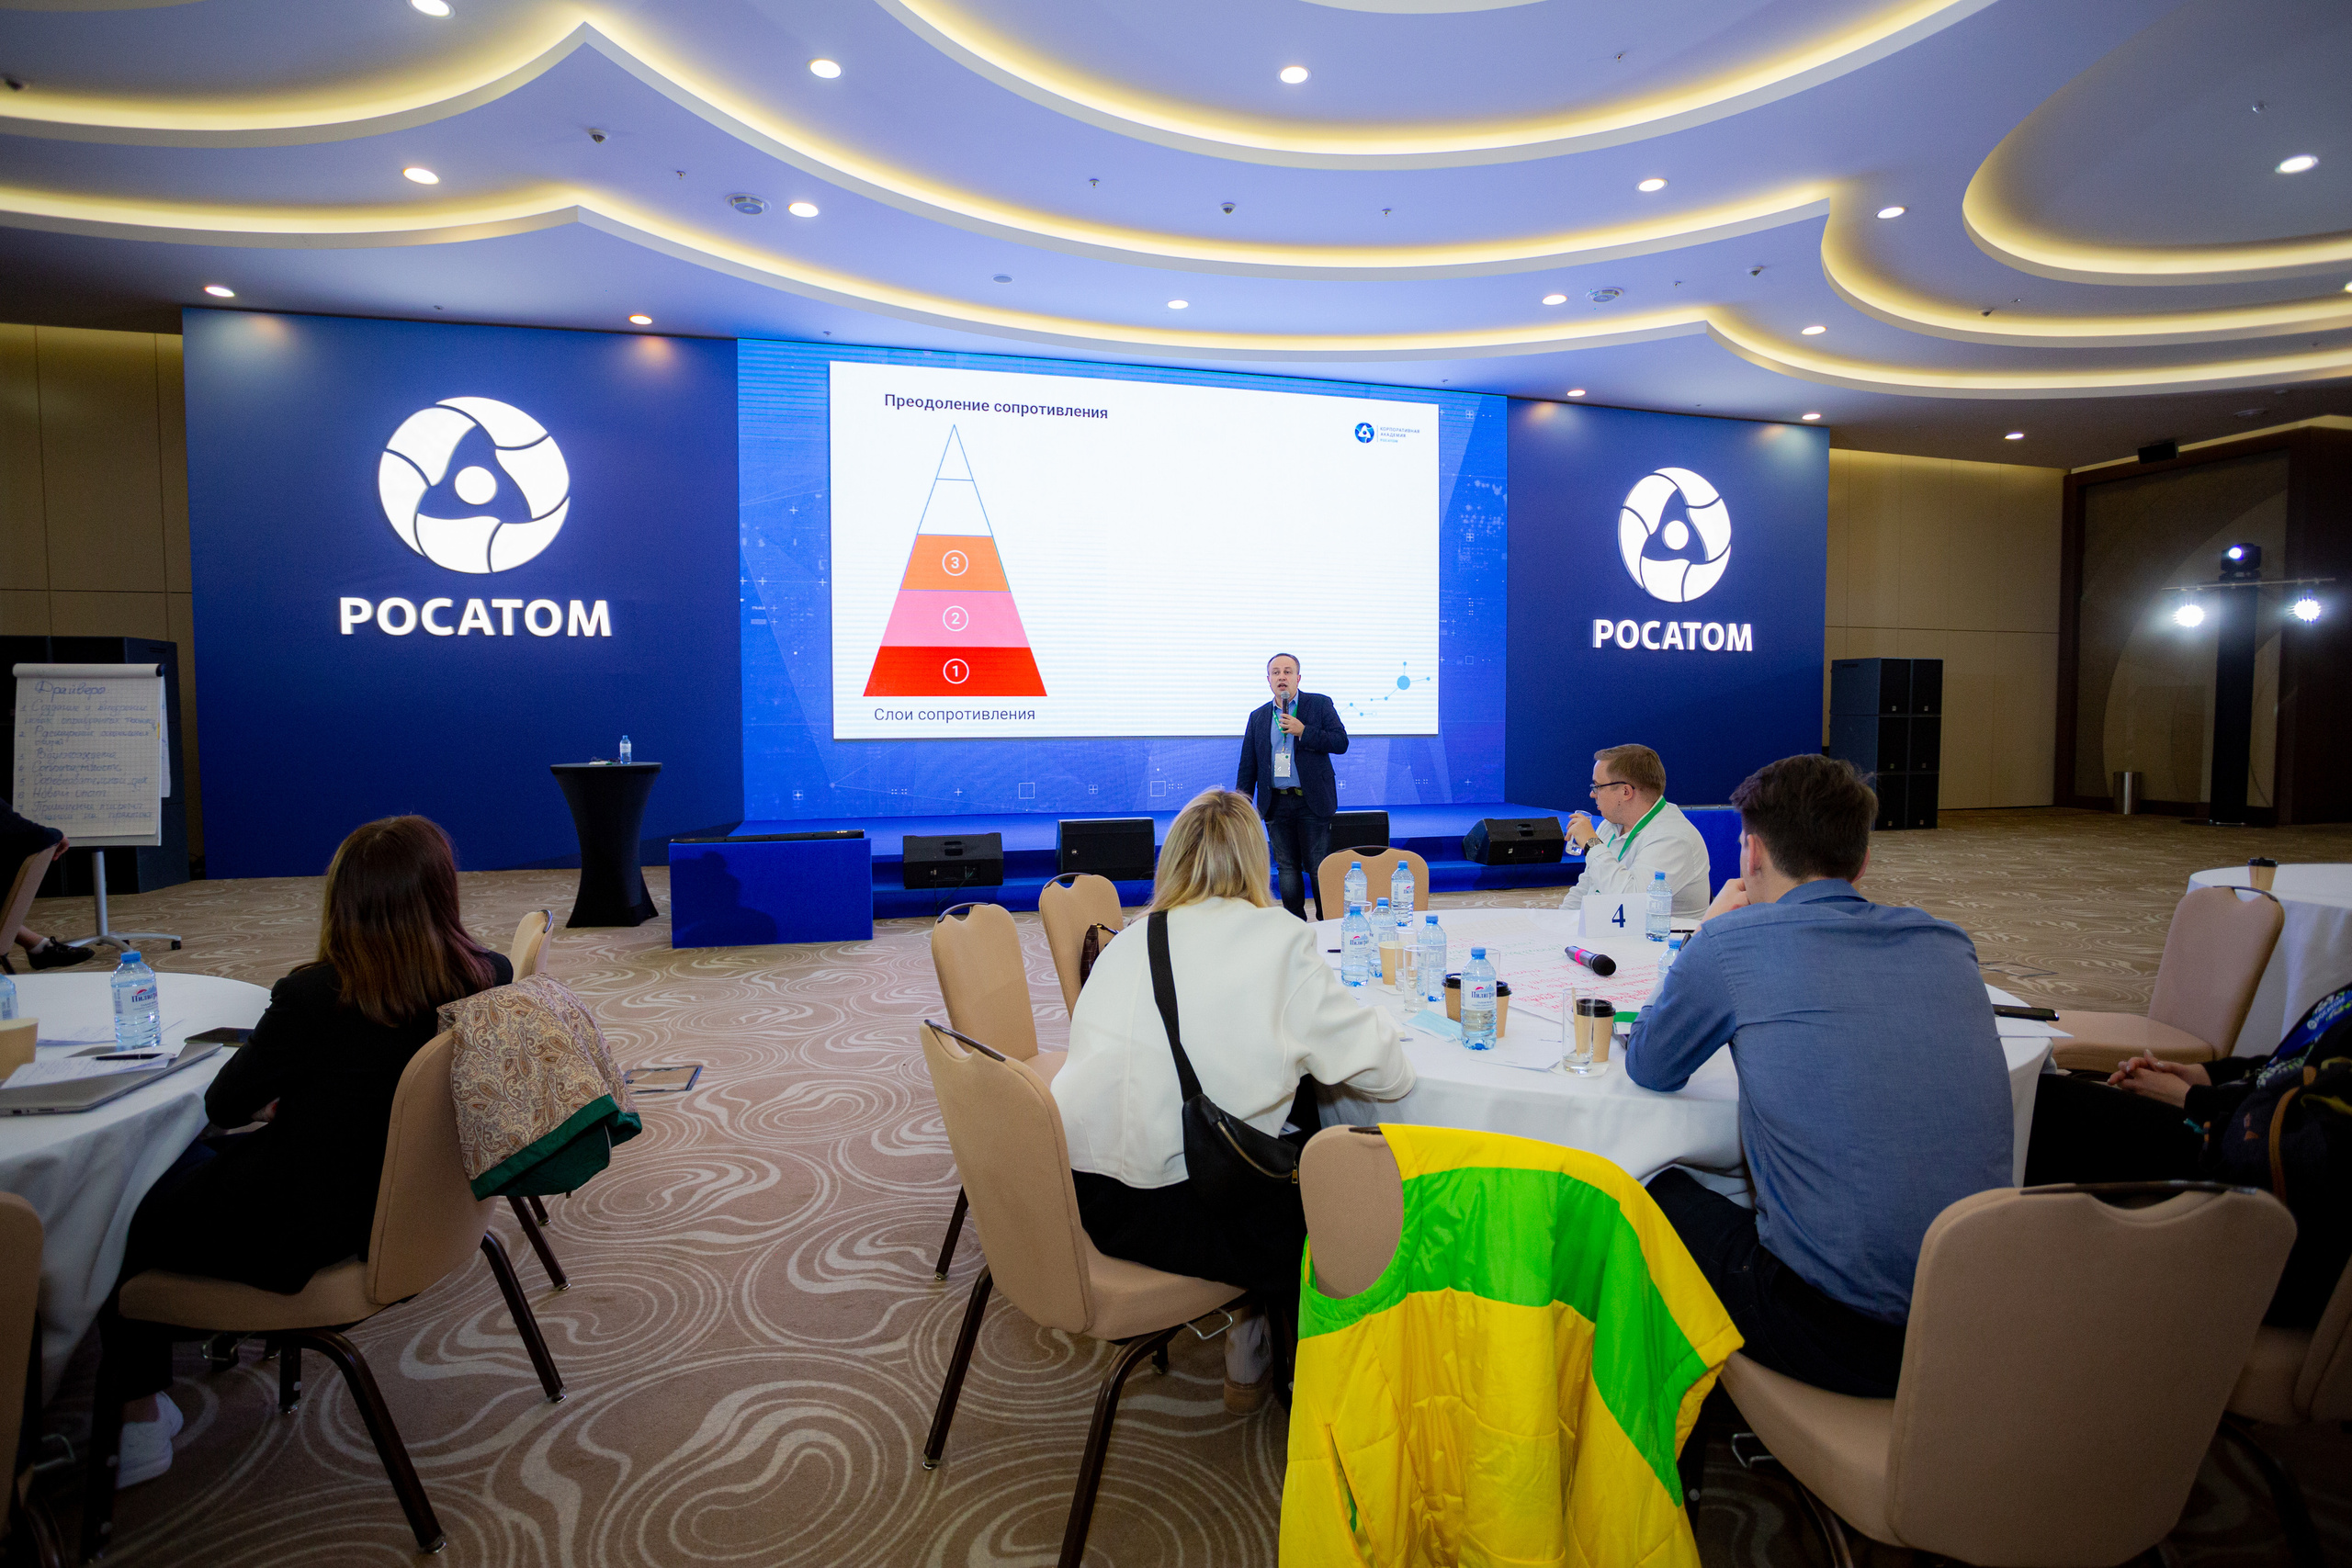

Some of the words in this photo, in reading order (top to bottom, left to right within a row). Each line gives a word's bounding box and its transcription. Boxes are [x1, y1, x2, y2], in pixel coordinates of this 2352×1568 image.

[884, 393, 989, 412] Преодоление
[993, 400, 1108, 419] сопротивления
[951, 557, 959, 569] 3
[339, 597, 612, 637] РОСАТОМ
[951, 613, 960, 625] 2
[1592, 618, 1753, 652] РОСАТОМ
[952, 665, 958, 677] 1
[874, 707, 913, 721] Слои
[918, 709, 1035, 723] сопротивления
[1611, 904, 1626, 928] 4
[1350, 939, 1369, 949] Пилигр
[131, 993, 157, 1003] Пилигр
[1471, 991, 1495, 999] Пилигр
